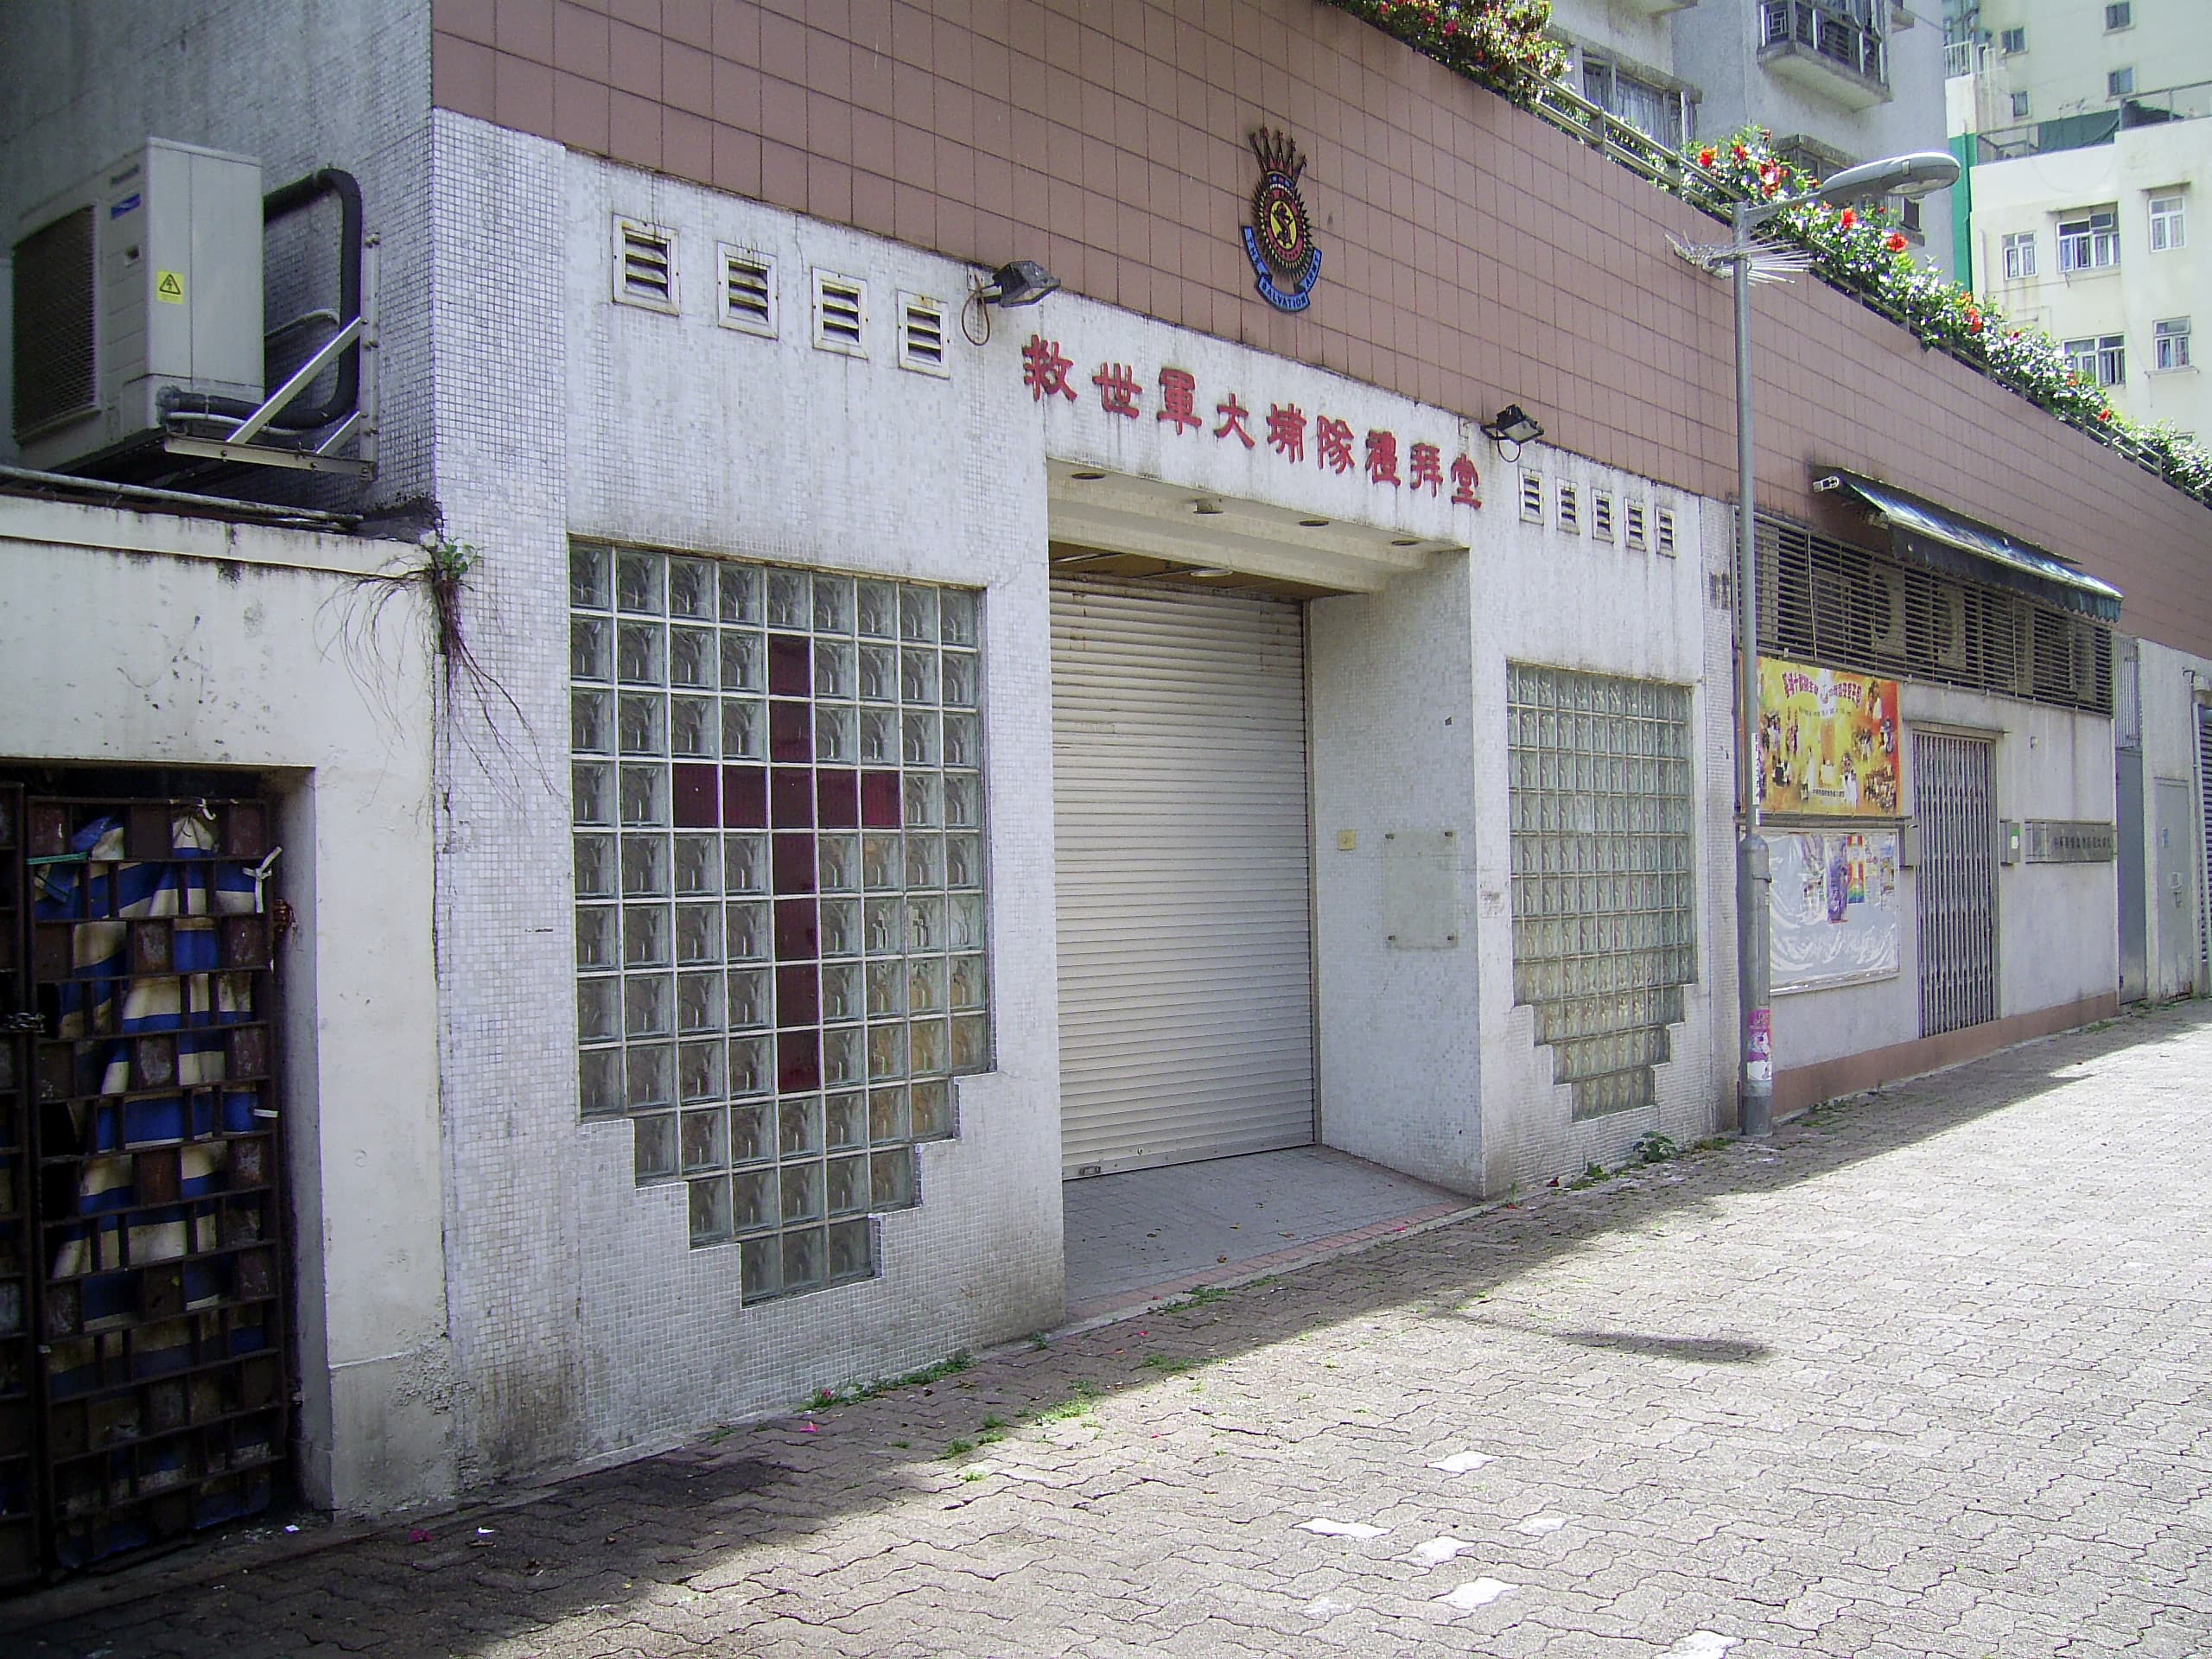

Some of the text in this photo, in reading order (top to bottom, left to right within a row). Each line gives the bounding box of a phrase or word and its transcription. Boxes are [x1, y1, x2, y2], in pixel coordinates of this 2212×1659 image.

[1262, 281, 1307, 308] SALVATION
[1021, 334, 1483, 510] 救世軍大埔隊禮拜堂
